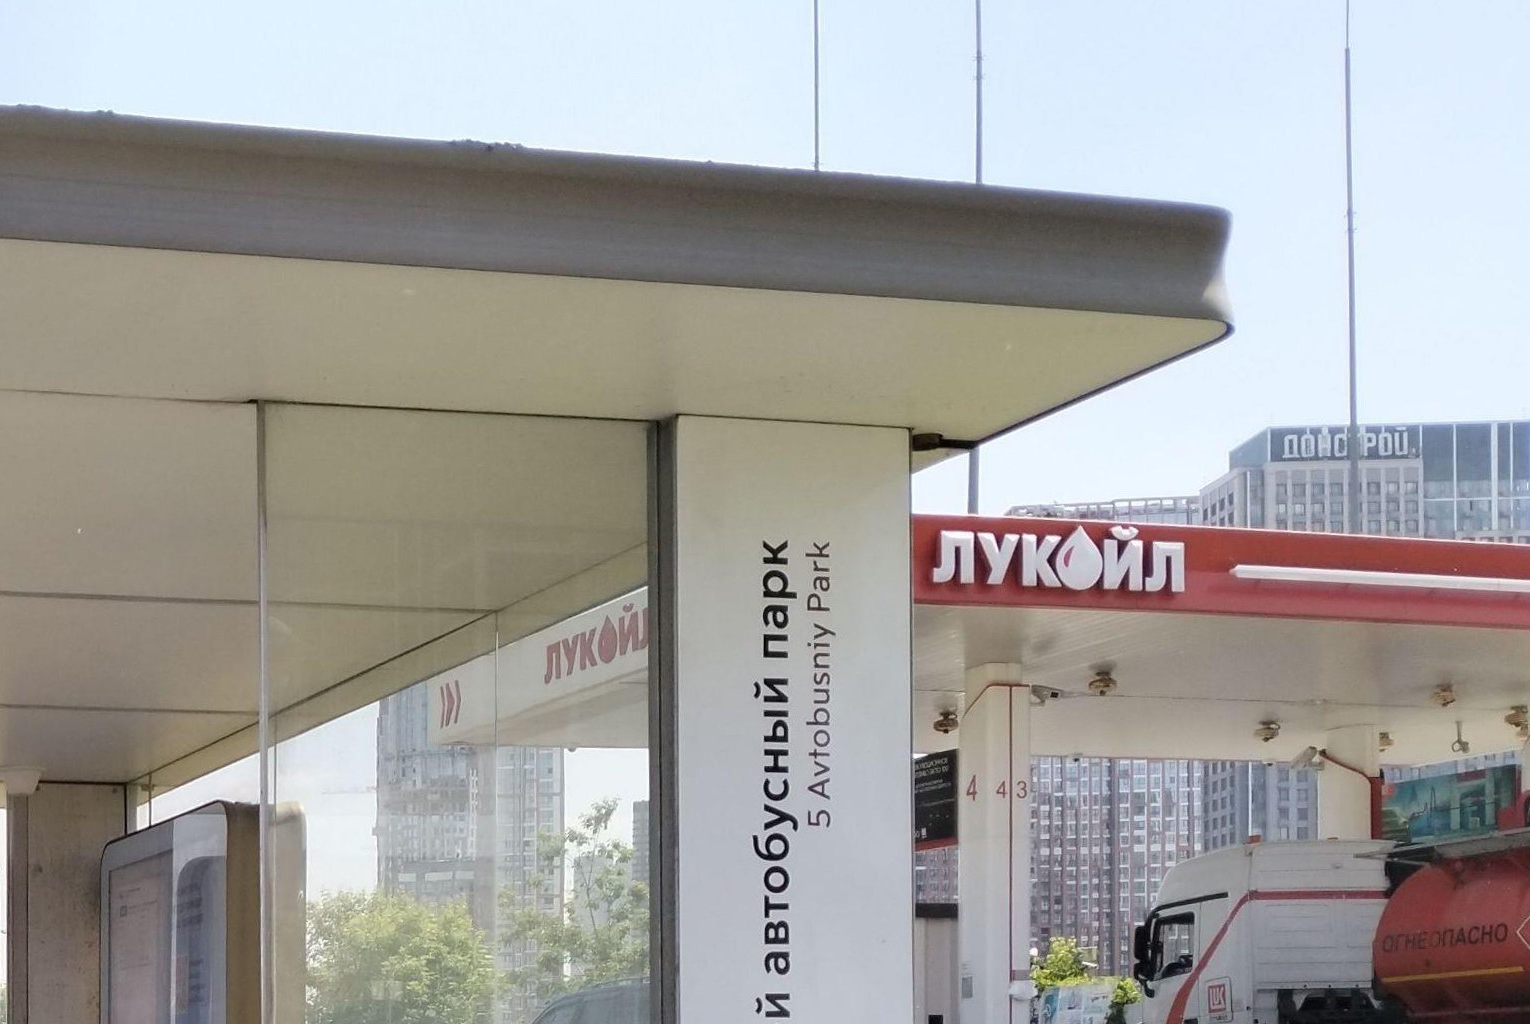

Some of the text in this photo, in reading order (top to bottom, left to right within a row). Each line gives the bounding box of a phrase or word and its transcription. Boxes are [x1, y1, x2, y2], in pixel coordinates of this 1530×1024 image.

[1282, 427, 1408, 458] ДОНСРОЙ
[932, 524, 1185, 593] ЛУКОЙЛ
[763, 540, 797, 659] парк
[805, 541, 836, 828] 5 Avtobusniy Park
[996, 780, 1008, 798] 4
[1016, 780, 1028, 799] 3
[752, 677, 799, 976] автобусный
[1381, 922, 1508, 953] ОГНЕОПАСНО
